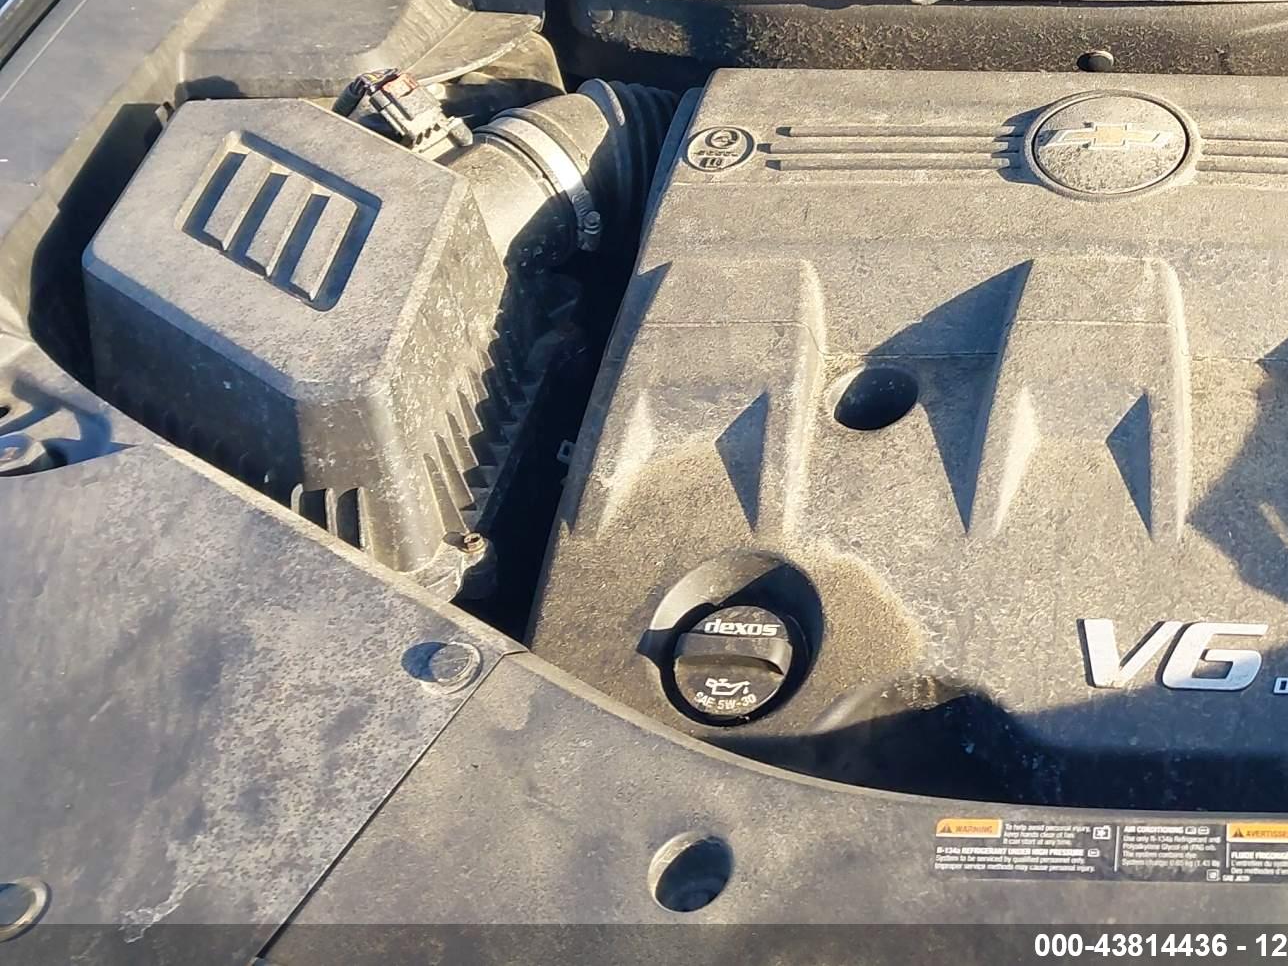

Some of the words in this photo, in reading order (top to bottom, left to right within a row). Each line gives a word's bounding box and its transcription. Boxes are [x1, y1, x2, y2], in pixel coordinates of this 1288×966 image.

[704, 619, 781, 636] dexos
[1078, 618, 1268, 690] V6
[694, 692, 715, 707] SAE
[718, 694, 756, 709] 5W-30
[955, 825, 992, 833] WARNING
